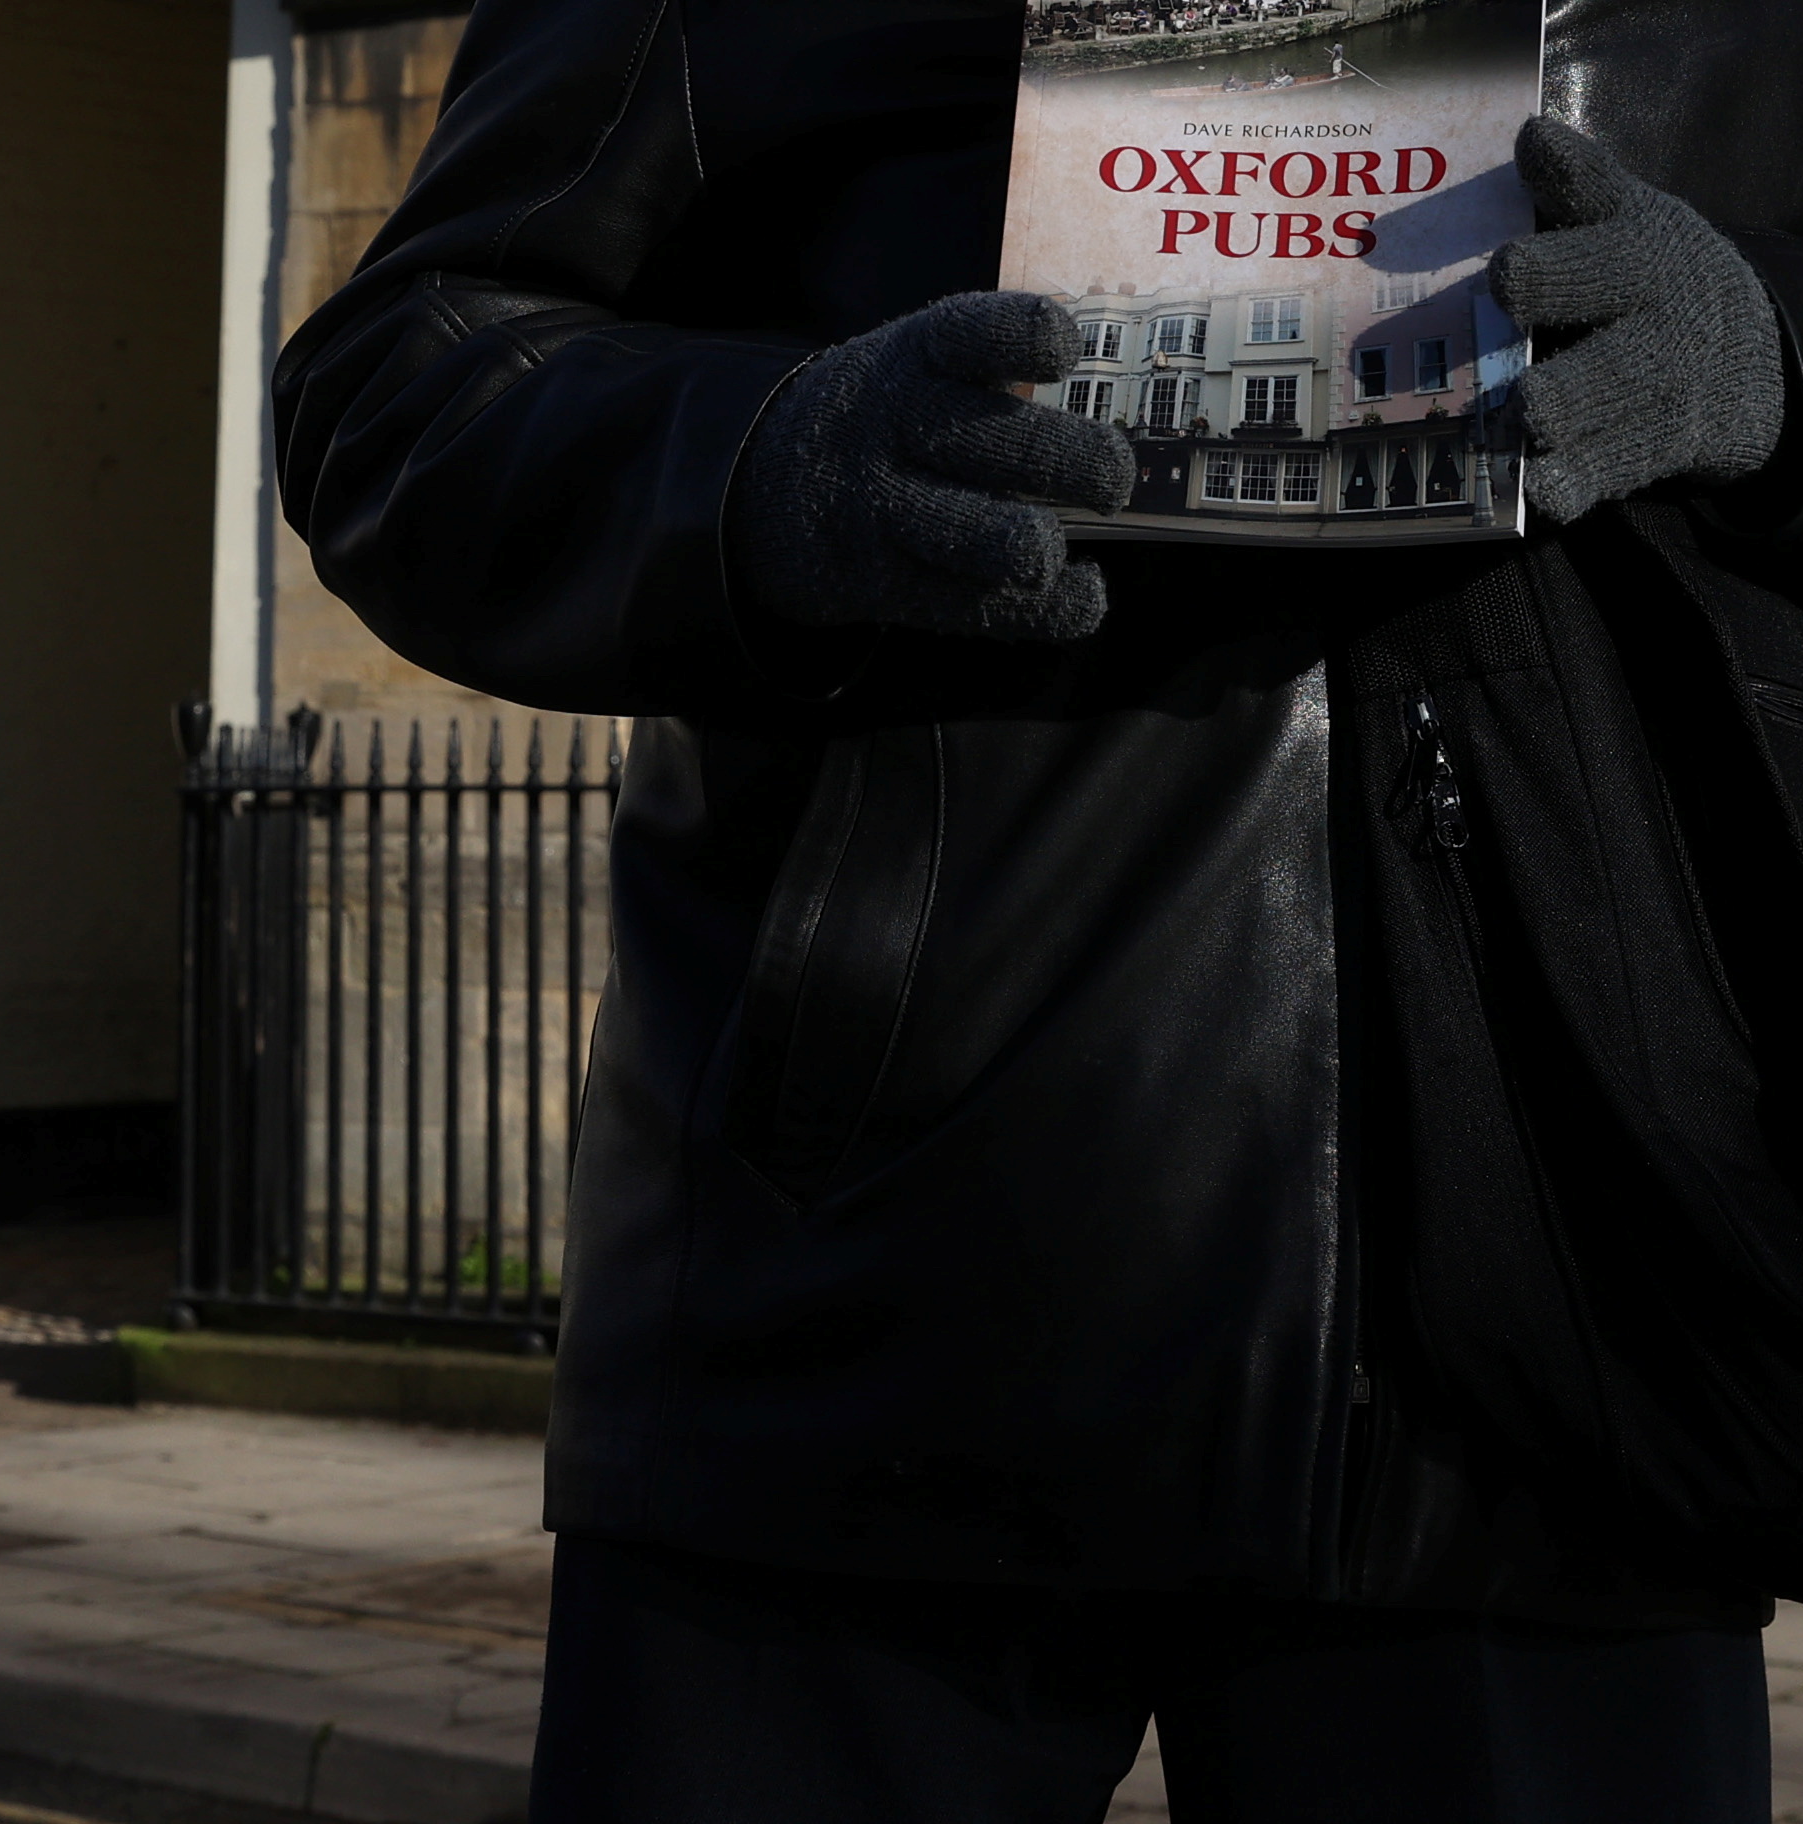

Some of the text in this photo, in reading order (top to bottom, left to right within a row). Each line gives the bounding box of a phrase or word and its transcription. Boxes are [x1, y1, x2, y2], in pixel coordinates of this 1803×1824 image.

[1182, 122, 1373, 139] DAVE RICHARDSON
[1096, 144, 1448, 199] OXFORD
[1156, 208, 1379, 261] PUBS
